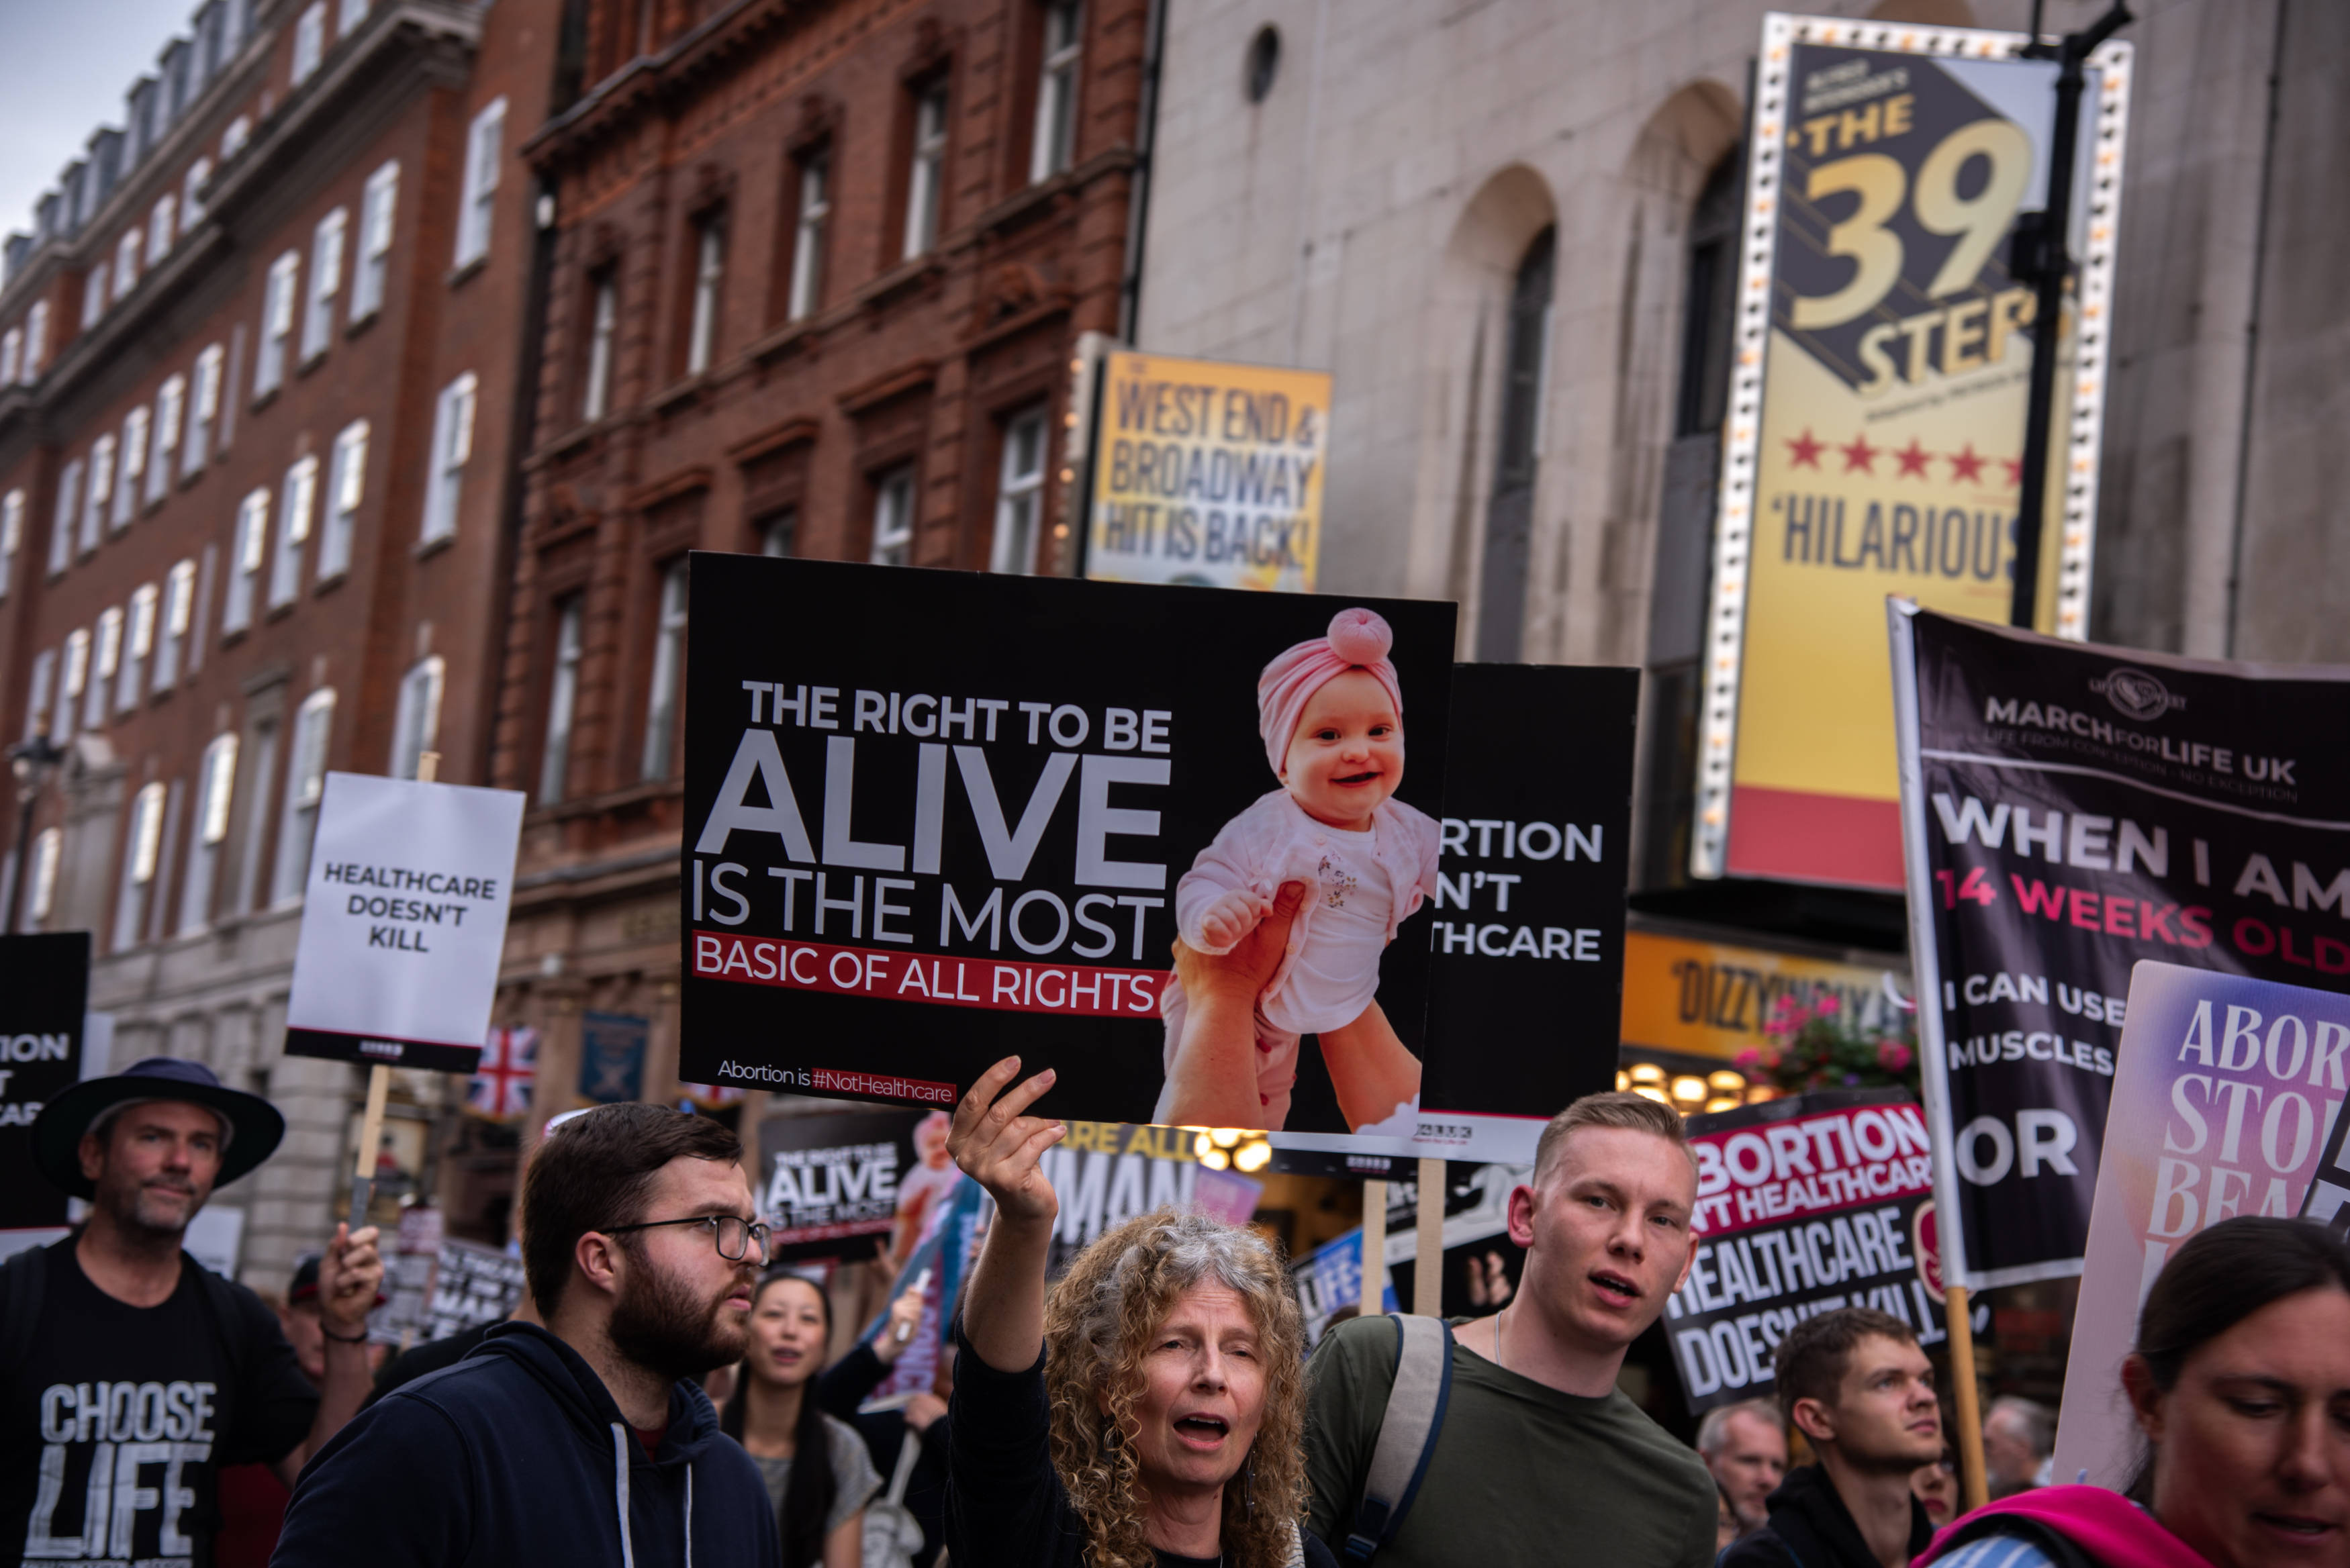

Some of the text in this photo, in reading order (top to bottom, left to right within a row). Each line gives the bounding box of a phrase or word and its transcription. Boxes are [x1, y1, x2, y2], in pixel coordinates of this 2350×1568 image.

[1802, 91, 1915, 157] THE
[1789, 117, 2034, 330] 39
[1859, 283, 2073, 397] STEP
[1117, 379, 1317, 448] WEST END &
[1110, 438, 1316, 509] BROADWAY
[1104, 501, 1309, 568] HIT IS BACK!
[743, 681, 1172, 753] THE RIGHT TO BE
[2243, 754, 2297, 785] UK
[694, 728, 1172, 890] ALIVE
[323, 863, 498, 900] HEALTHCARE
[1932, 792, 2350, 920] WHEN I AM
[346, 895, 468, 926] DOESN'T
[369, 926, 430, 952] KILL
[692, 859, 751, 926] IS
[768, 867, 915, 944] THE
[940, 883, 1164, 961] MOST
[1936, 867, 2350, 975] 14 WEEKS OLD
[696, 936, 1154, 1012] BASIC OF ALL RIGHTS
[1944, 972, 2126, 1028] I CAN USE
[0, 1033, 70, 1061] ION
[1949, 1030, 2114, 1077] MUSCLES
[2177, 999, 2350, 1091] ABOR
[718, 1060, 953, 1102] Abortion is #NotHealthcare
[1125, 1125, 1199, 1162] ALL
[1956, 1108, 2080, 1187] OR
[767, 1159, 898, 1212] ALIVE
[40, 1380, 218, 1444] CHOOSE
[23, 1440, 213, 1559] LIFE
